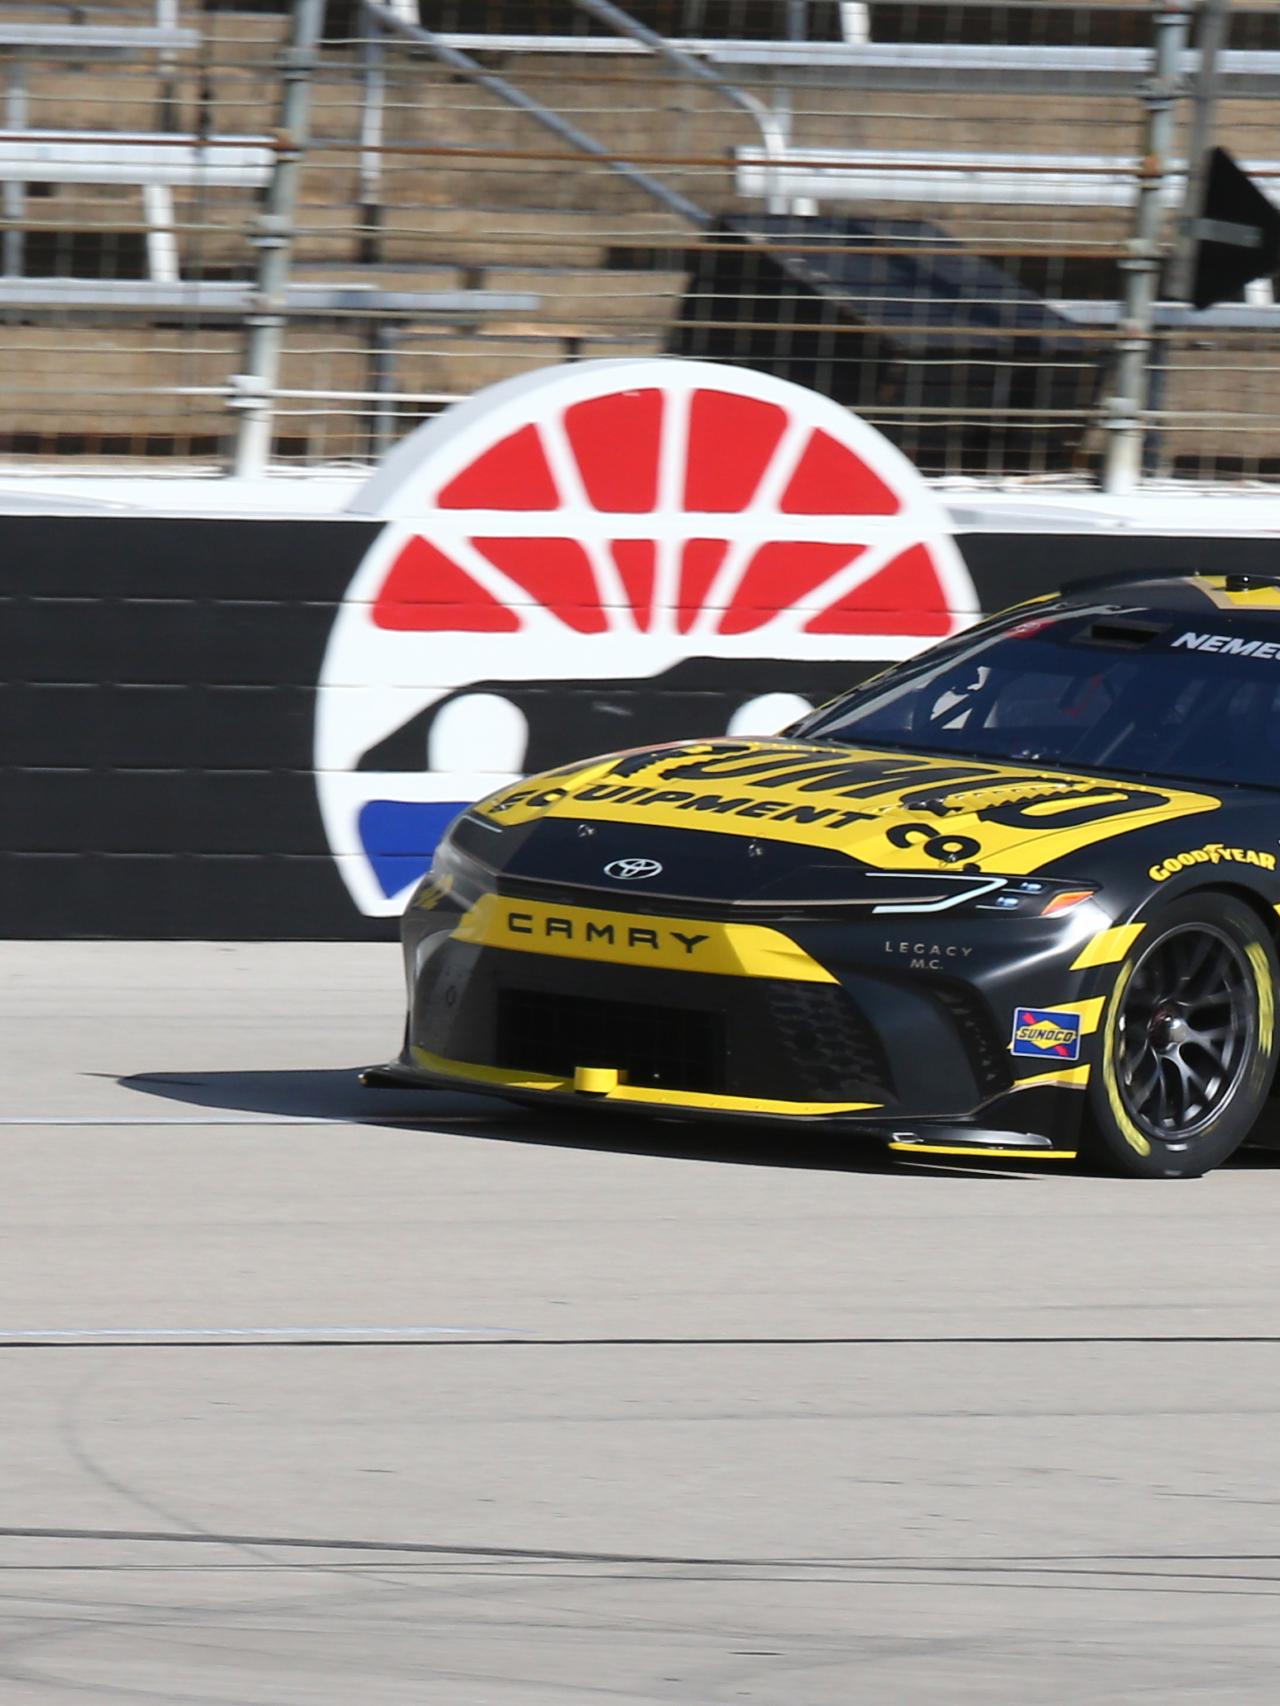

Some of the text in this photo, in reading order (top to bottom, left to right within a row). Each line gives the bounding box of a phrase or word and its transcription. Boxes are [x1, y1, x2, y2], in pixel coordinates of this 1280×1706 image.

[488, 782, 881, 829] EQUIPMENT
[1148, 844, 1276, 881] GOODYEAR
[508, 912, 710, 954] CAMRY
[885, 941, 973, 957] LEGACY
[1018, 1028, 1075, 1042] SUNOCO
